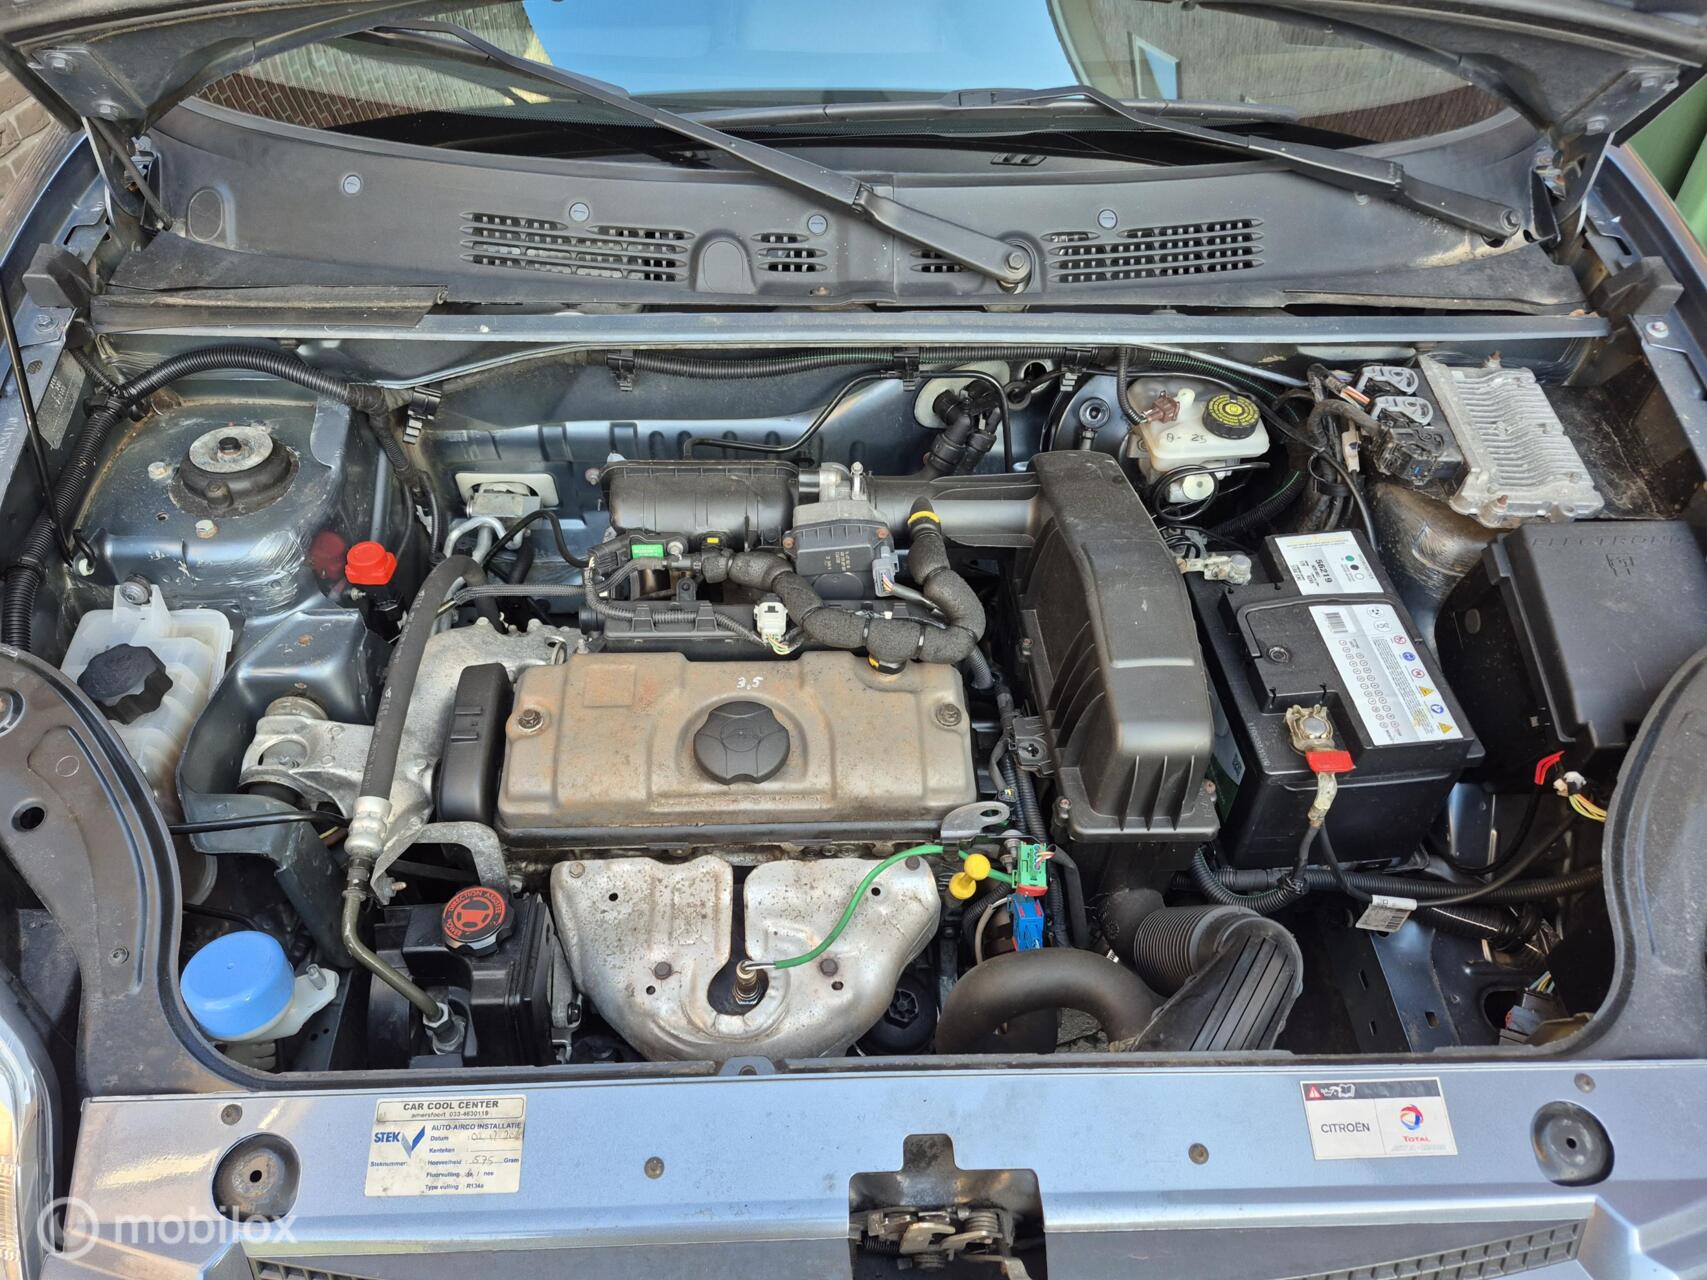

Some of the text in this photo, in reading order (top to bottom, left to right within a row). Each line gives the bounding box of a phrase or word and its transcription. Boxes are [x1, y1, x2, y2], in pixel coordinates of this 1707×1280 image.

[1315, 559, 1333, 582] 56219
[403, 1100, 499, 1111] CAR COOL CENTER
[411, 1111, 446, 1119] amersfoort
[431, 1123, 475, 1131] AUTO-AIRCO
[1320, 1122, 1370, 1133] CITROËN
[374, 1132, 401, 1143] STEK
[1403, 1135, 1431, 1143] TOTAL
[440, 1183, 459, 1191] vulling
